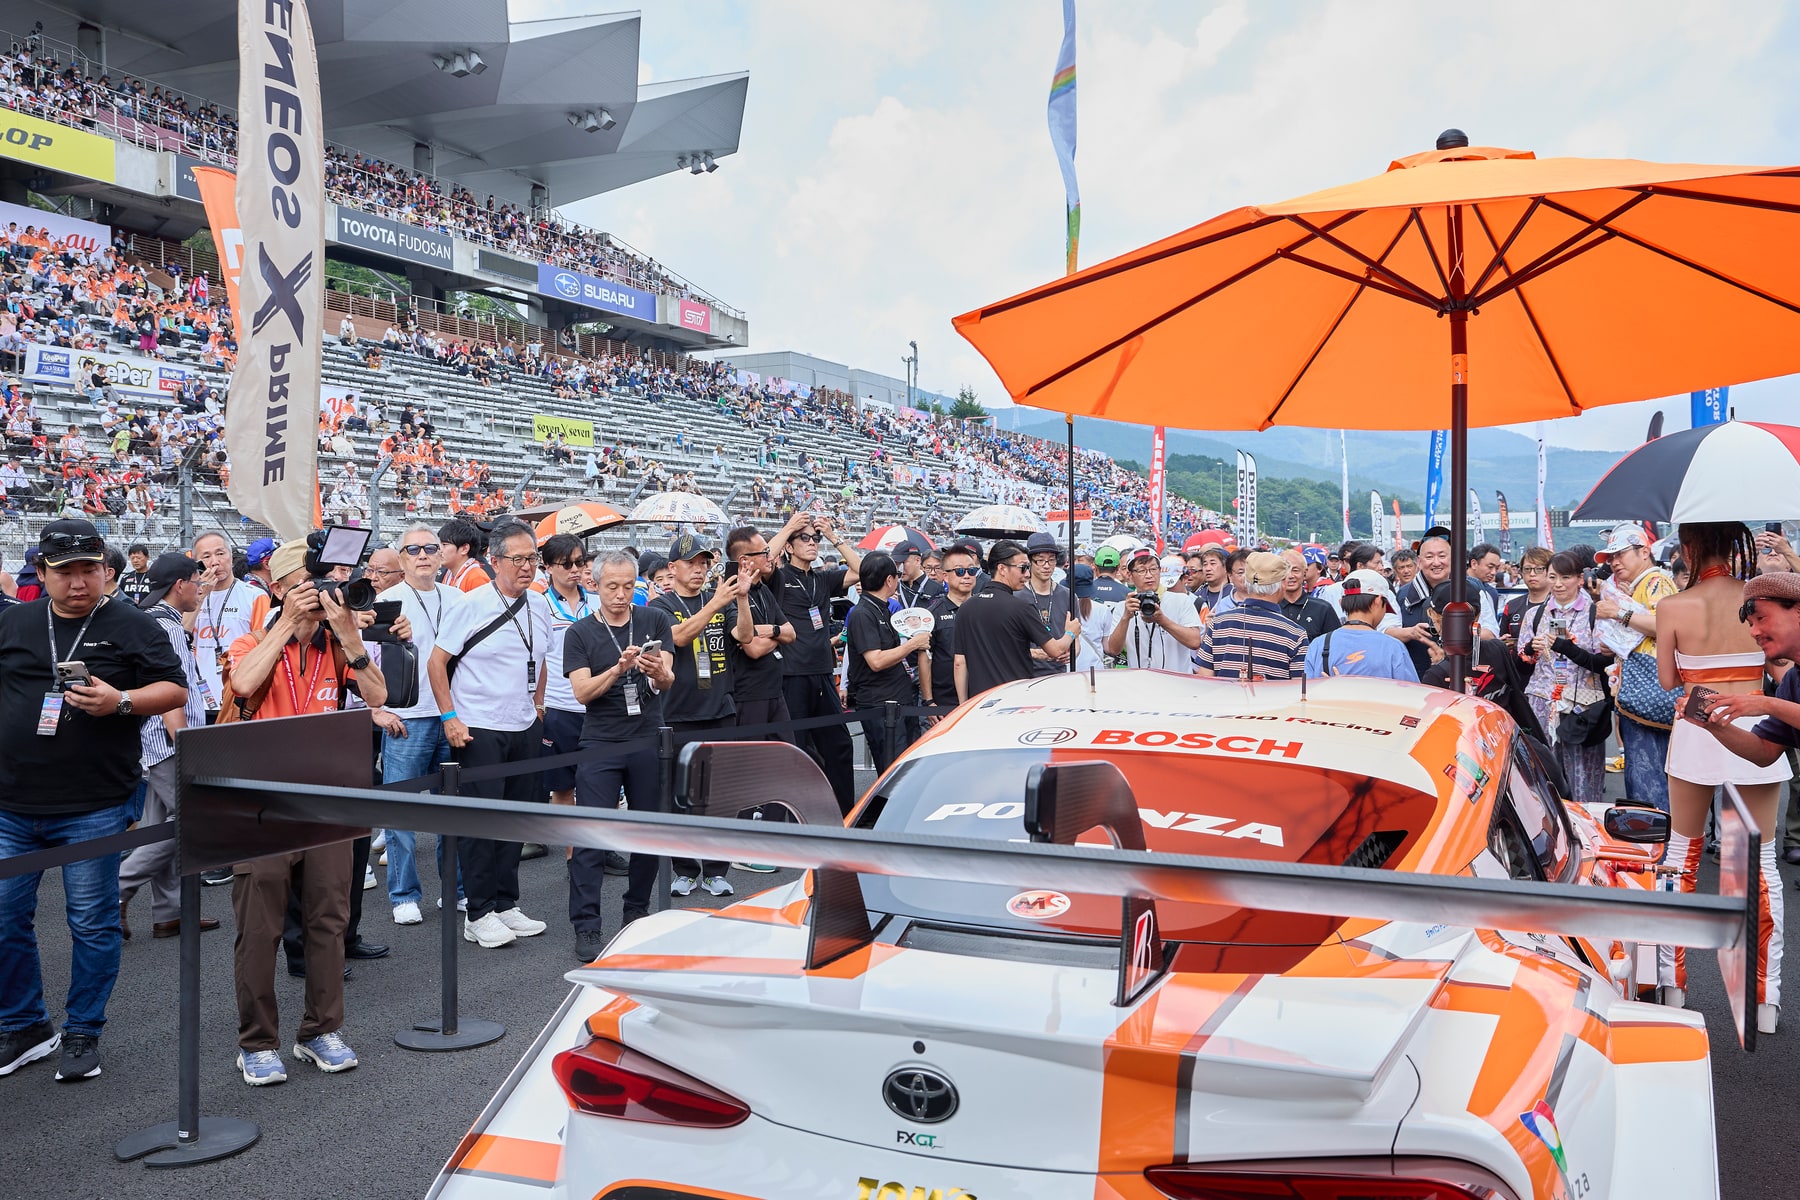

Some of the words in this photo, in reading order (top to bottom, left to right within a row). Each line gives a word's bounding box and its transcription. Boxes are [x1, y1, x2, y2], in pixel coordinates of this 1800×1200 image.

[0, 127, 53, 150] OP
[66, 233, 101, 254] au
[341, 217, 397, 246] TOYOTA
[399, 233, 451, 260] FUDOSAN
[584, 284, 635, 309] SUBARU
[537, 423, 560, 434] seven
[569, 427, 590, 438] seven
[1434, 518, 1475, 526] anaic
[124, 584, 151, 593] ARTA
[199, 624, 231, 639] au
[1050, 707, 1160, 716] TOYOTA
[1168, 712, 1279, 721] GAZOO
[1284, 716, 1393, 736] Racing
[1090, 729, 1304, 759] BOSCH
[924, 802, 1285, 848] PONZA
[896, 1130, 937, 1148] FXGT
